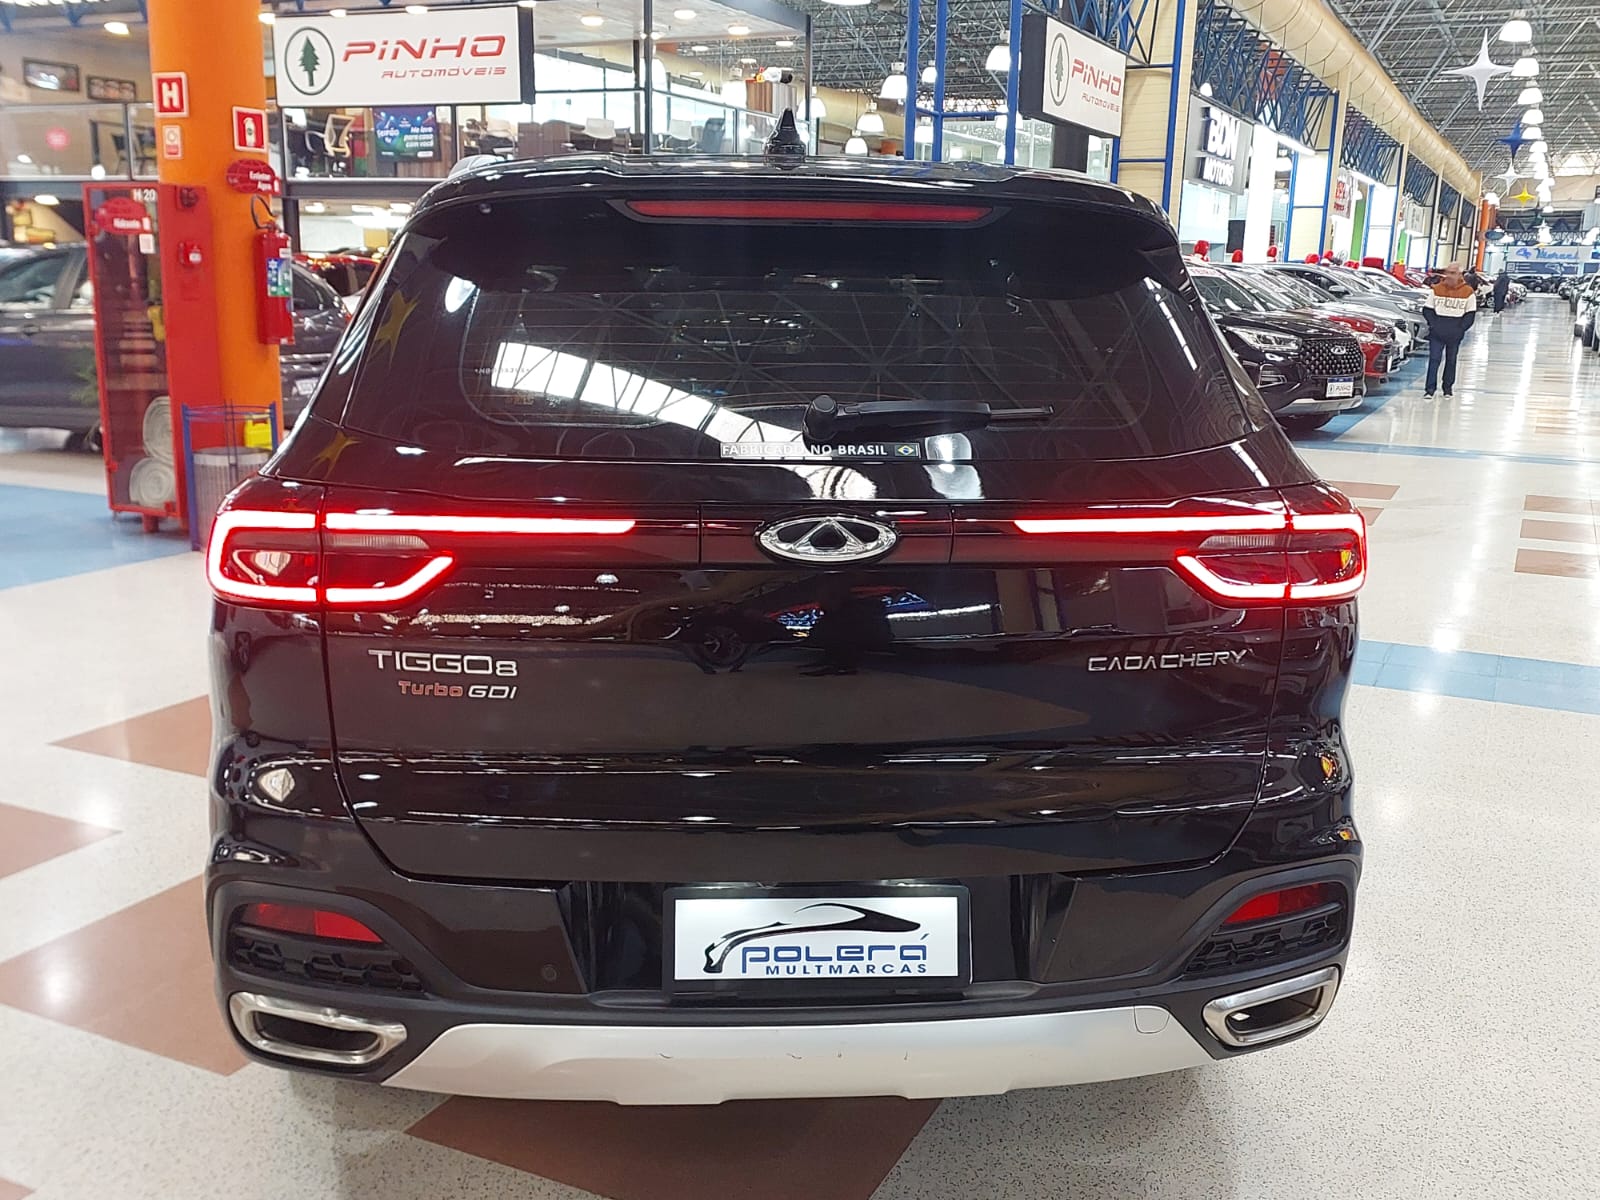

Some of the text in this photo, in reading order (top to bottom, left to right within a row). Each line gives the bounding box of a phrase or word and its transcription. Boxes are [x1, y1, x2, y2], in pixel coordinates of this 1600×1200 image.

[161, 81, 181, 109] H
[810, 444, 832, 455] NO
[837, 444, 888, 456] BRASIL
[398, 680, 518, 700] Turbo GDI
[765, 963, 928, 976] MULTMARCAS
